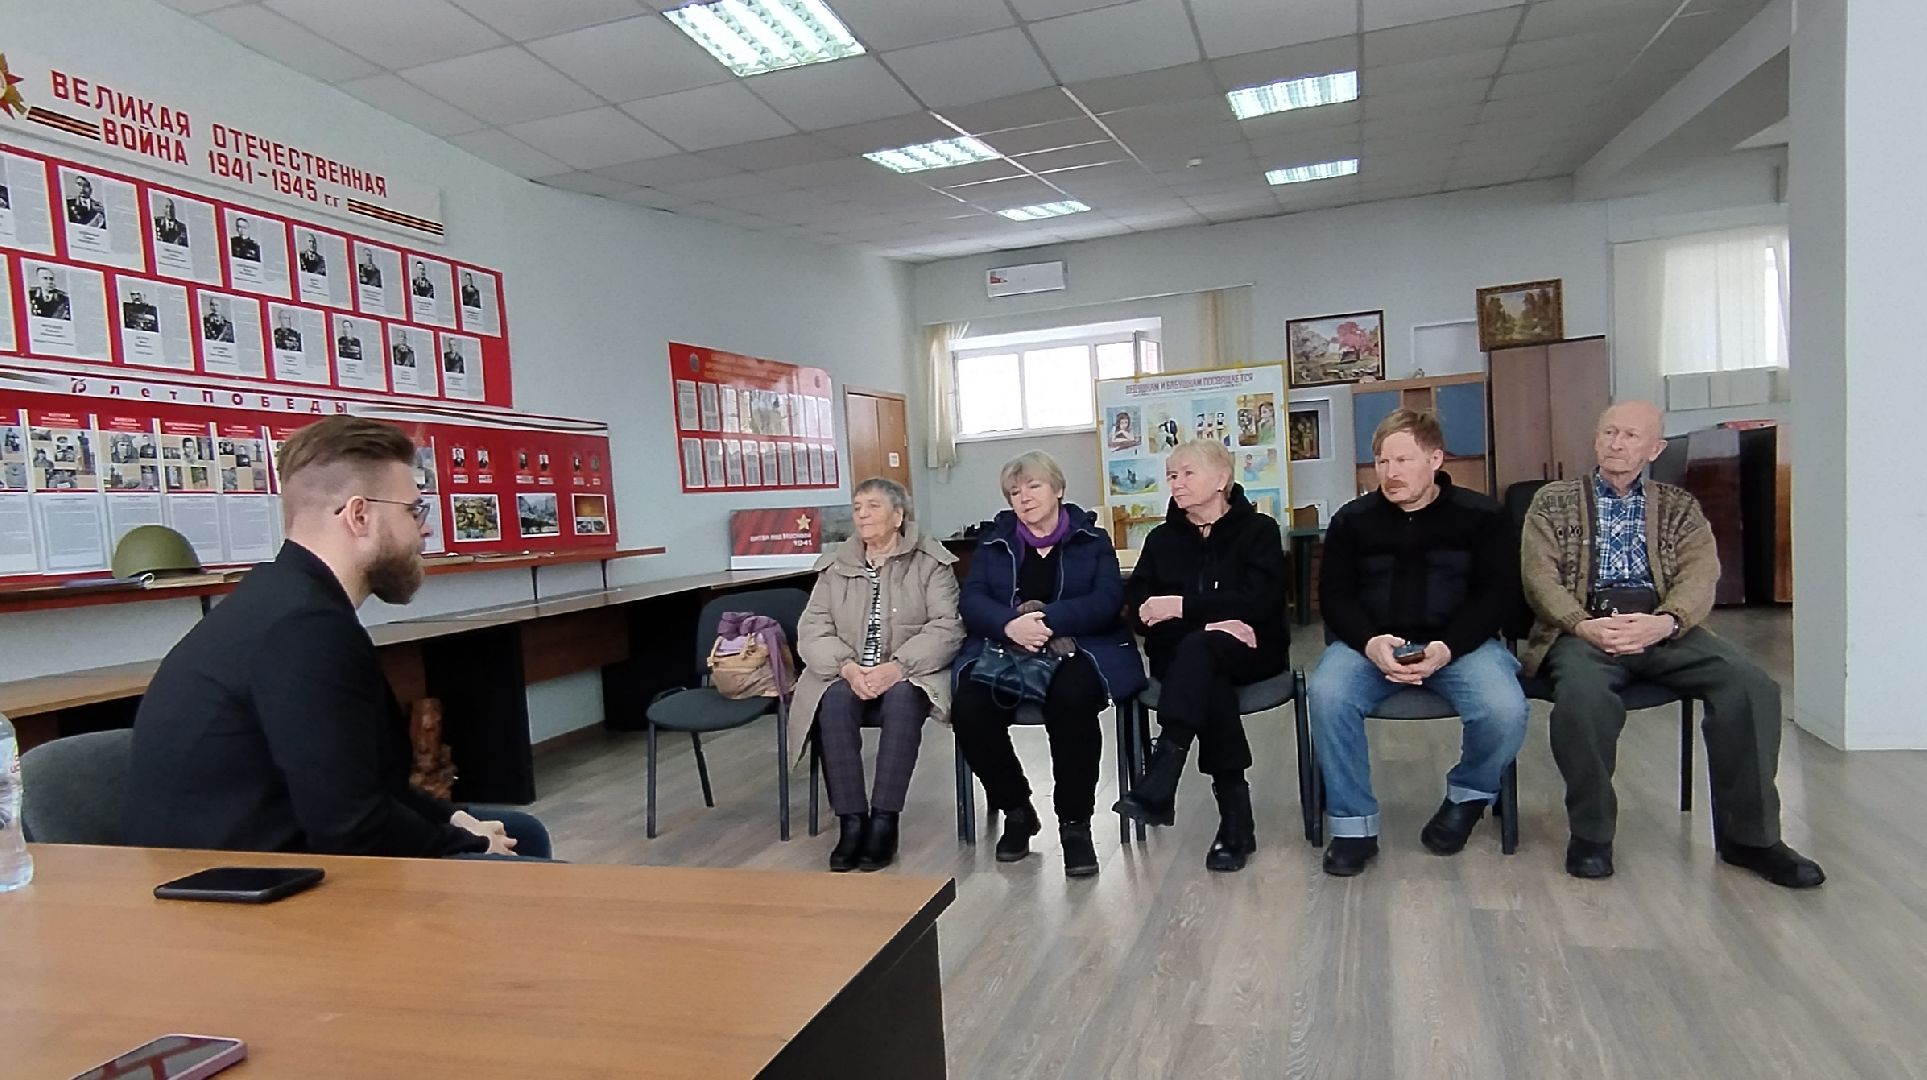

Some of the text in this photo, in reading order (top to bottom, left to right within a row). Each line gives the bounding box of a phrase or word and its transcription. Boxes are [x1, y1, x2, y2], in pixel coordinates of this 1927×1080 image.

[50, 70, 388, 198] ВЕЛИКАЯ ОТЕЧЕСТВЕННАЯ
[101, 117, 188, 166] ВОЙНА
[201, 390, 348, 414] ПОБЕДЫ
